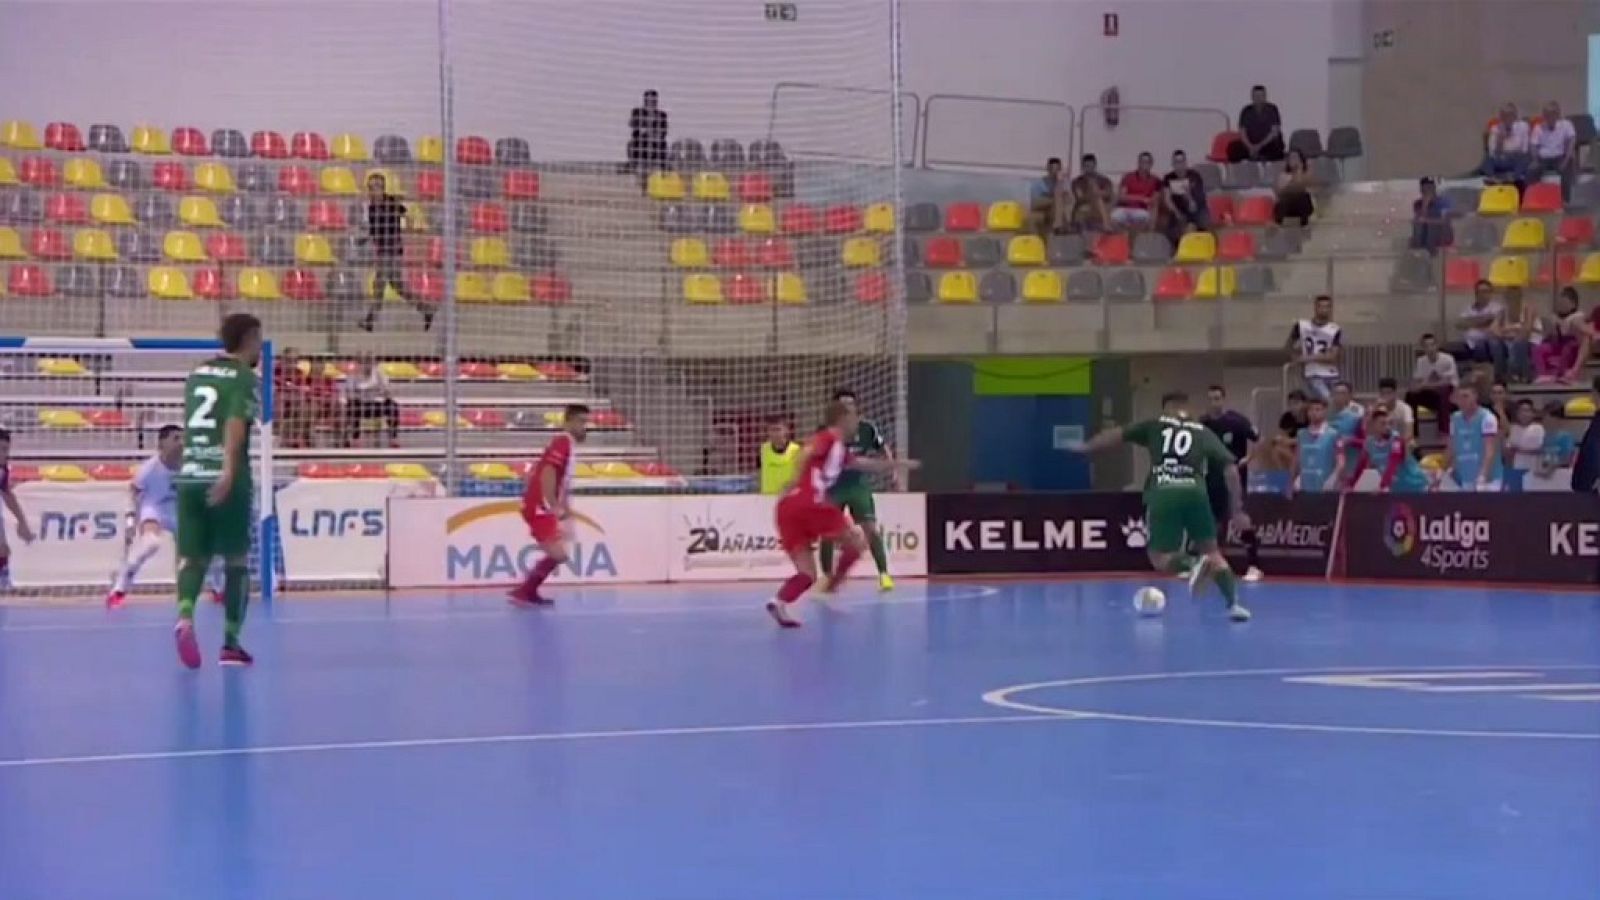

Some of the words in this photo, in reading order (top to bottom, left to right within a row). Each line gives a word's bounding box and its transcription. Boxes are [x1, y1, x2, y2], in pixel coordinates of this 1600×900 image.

[188, 385, 218, 428] 2
[1161, 427, 1193, 456] 10
[40, 511, 118, 541] NFS
[945, 519, 1108, 551] KELME
[1420, 511, 1491, 548] LaLiga
[1420, 544, 1490, 575] 4Sports
